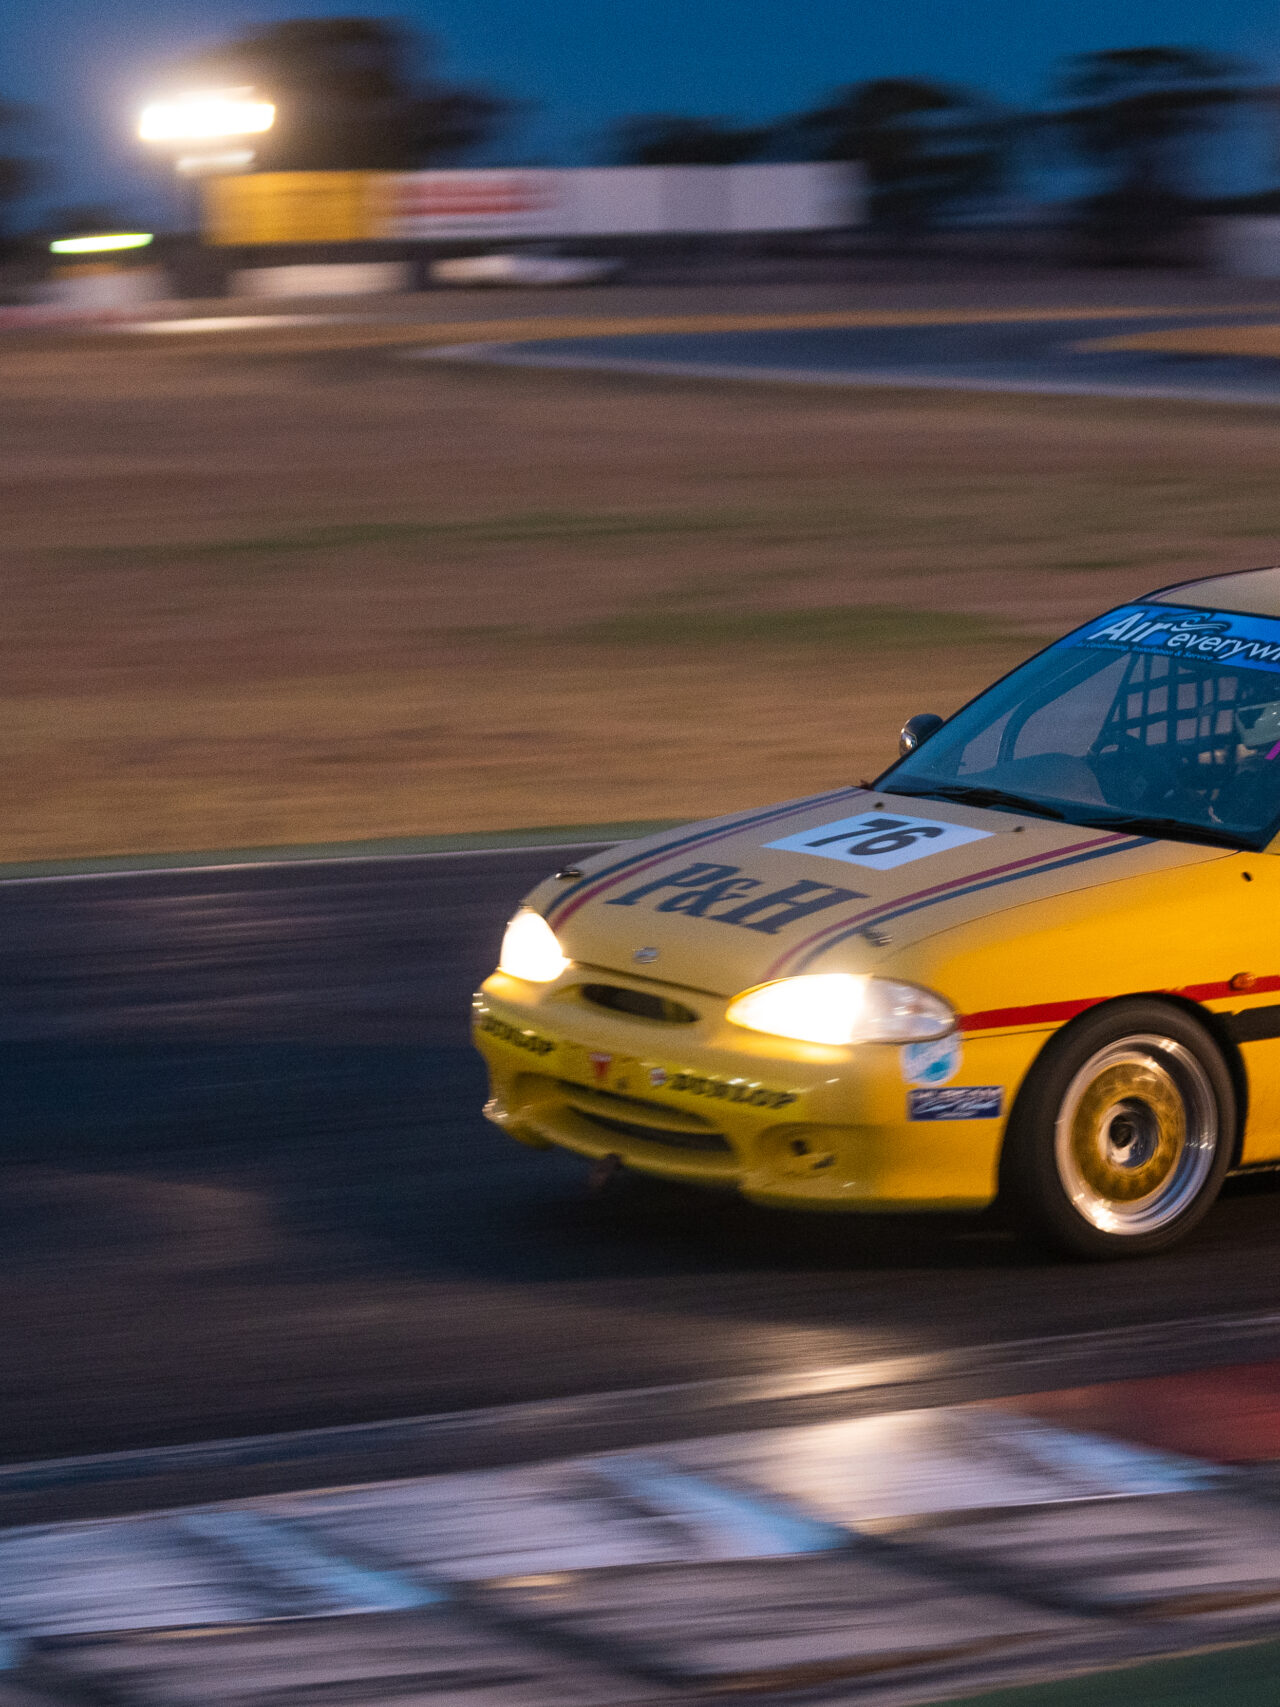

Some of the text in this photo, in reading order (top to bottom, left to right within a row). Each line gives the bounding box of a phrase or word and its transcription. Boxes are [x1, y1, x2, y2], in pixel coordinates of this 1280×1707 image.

[1086, 612, 1174, 642] Air
[804, 817, 946, 856] 76
[604, 862, 873, 935] P&H
